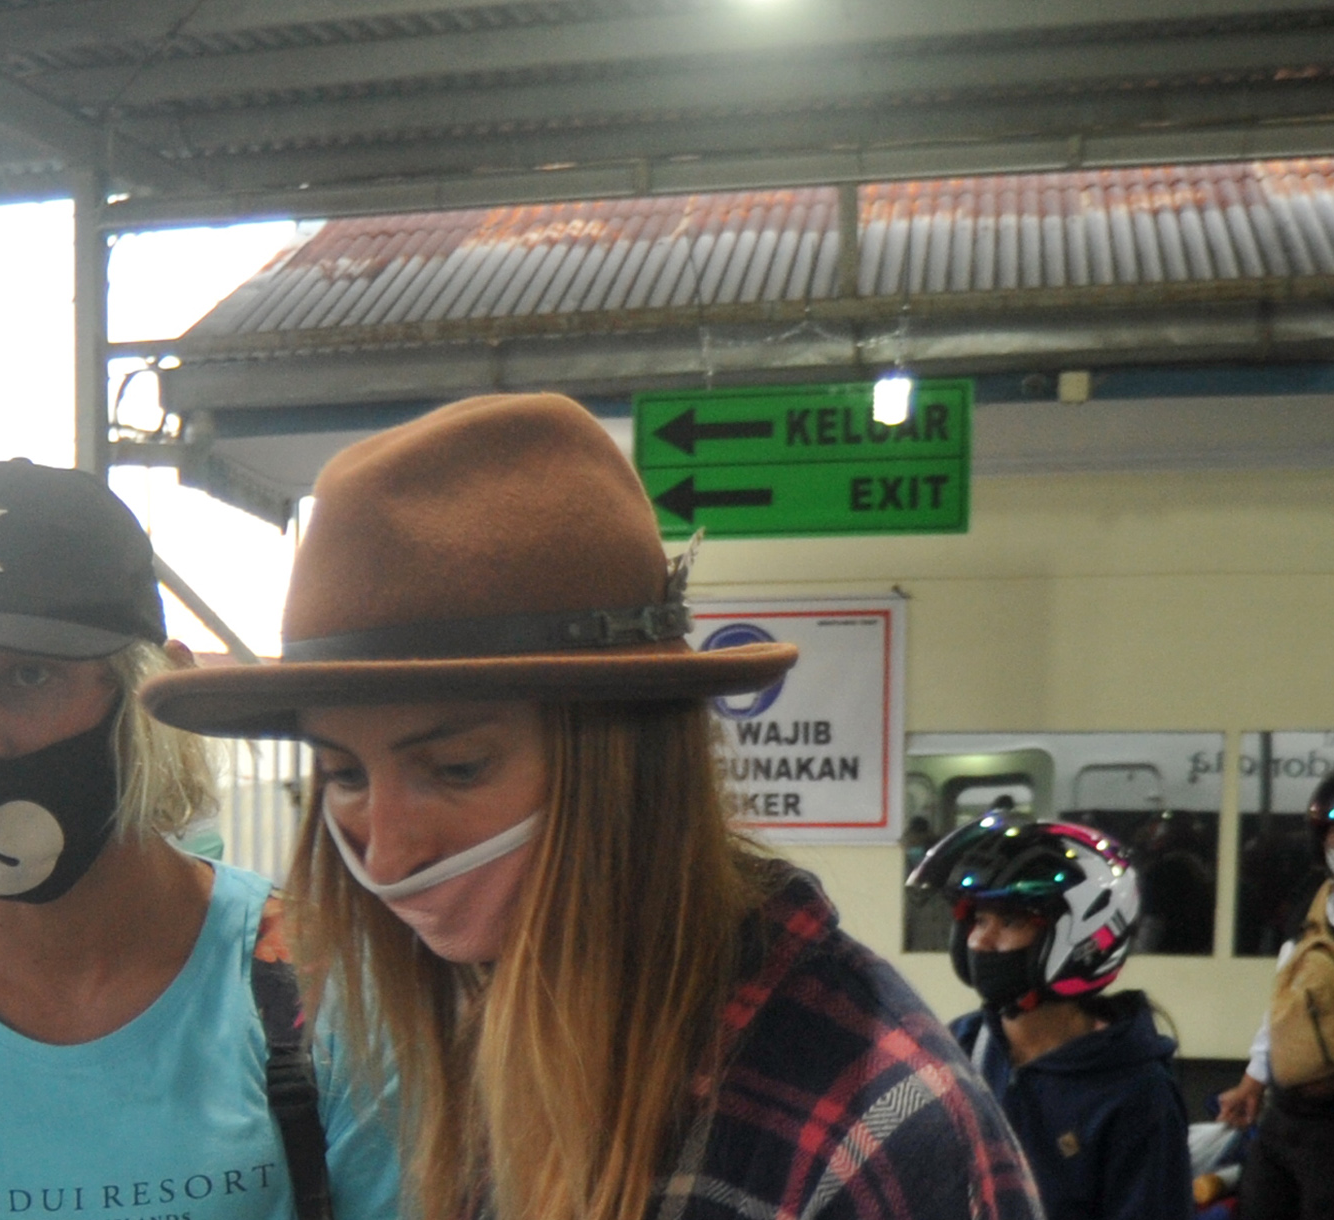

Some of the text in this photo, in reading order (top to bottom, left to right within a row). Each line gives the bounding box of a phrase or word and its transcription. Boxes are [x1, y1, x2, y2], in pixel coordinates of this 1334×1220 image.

[849, 475, 950, 512] EXIT
[737, 720, 832, 746] WAJIB
[102, 1163, 276, 1209] RESORT
